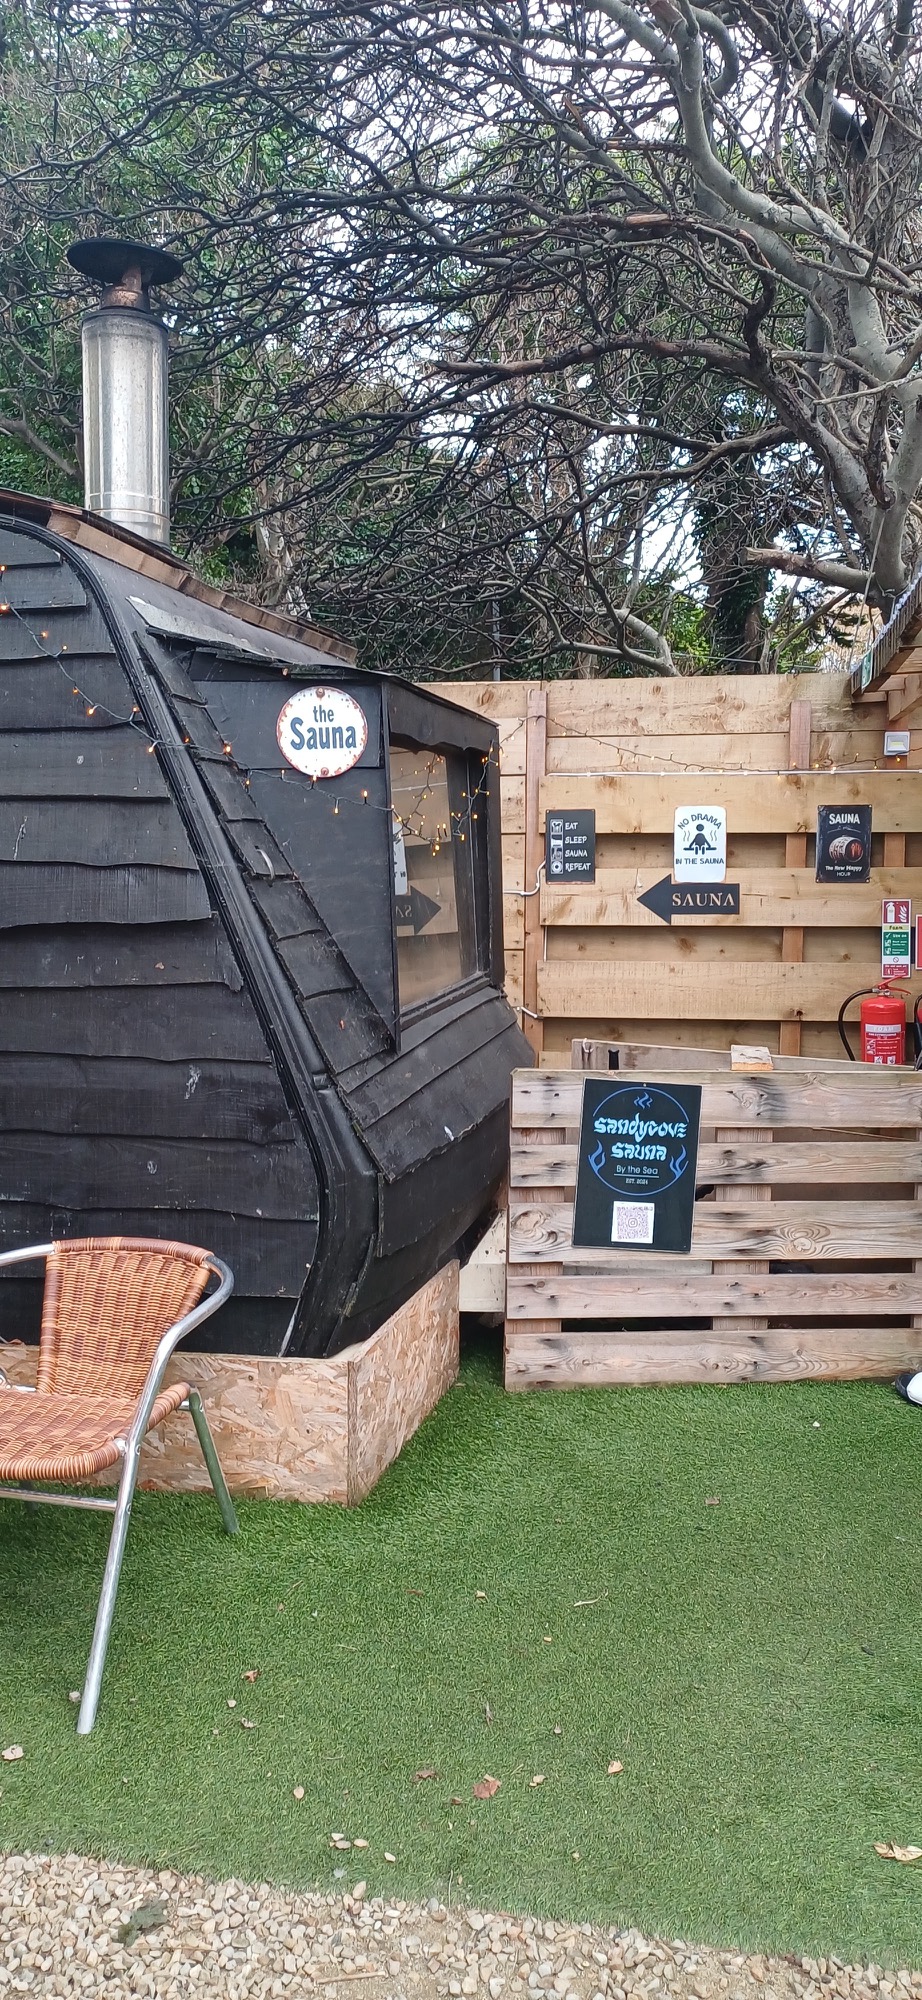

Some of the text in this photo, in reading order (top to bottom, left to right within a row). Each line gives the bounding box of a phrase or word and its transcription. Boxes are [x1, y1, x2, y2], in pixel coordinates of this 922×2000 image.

[313, 704, 335, 722] the
[290, 717, 357, 750] Sauna
[677, 813, 722, 830] NO DRAMA
[829, 813, 861, 825] SAUNA
[565, 822, 579, 830] EAT
[565, 836, 588, 844] SLEEP
[565, 849, 588, 858] SAUNA
[565, 862, 591, 872] REPEAT
[671, 892, 735, 907] SAUNA
[616, 1164, 658, 1175] By the Sea
